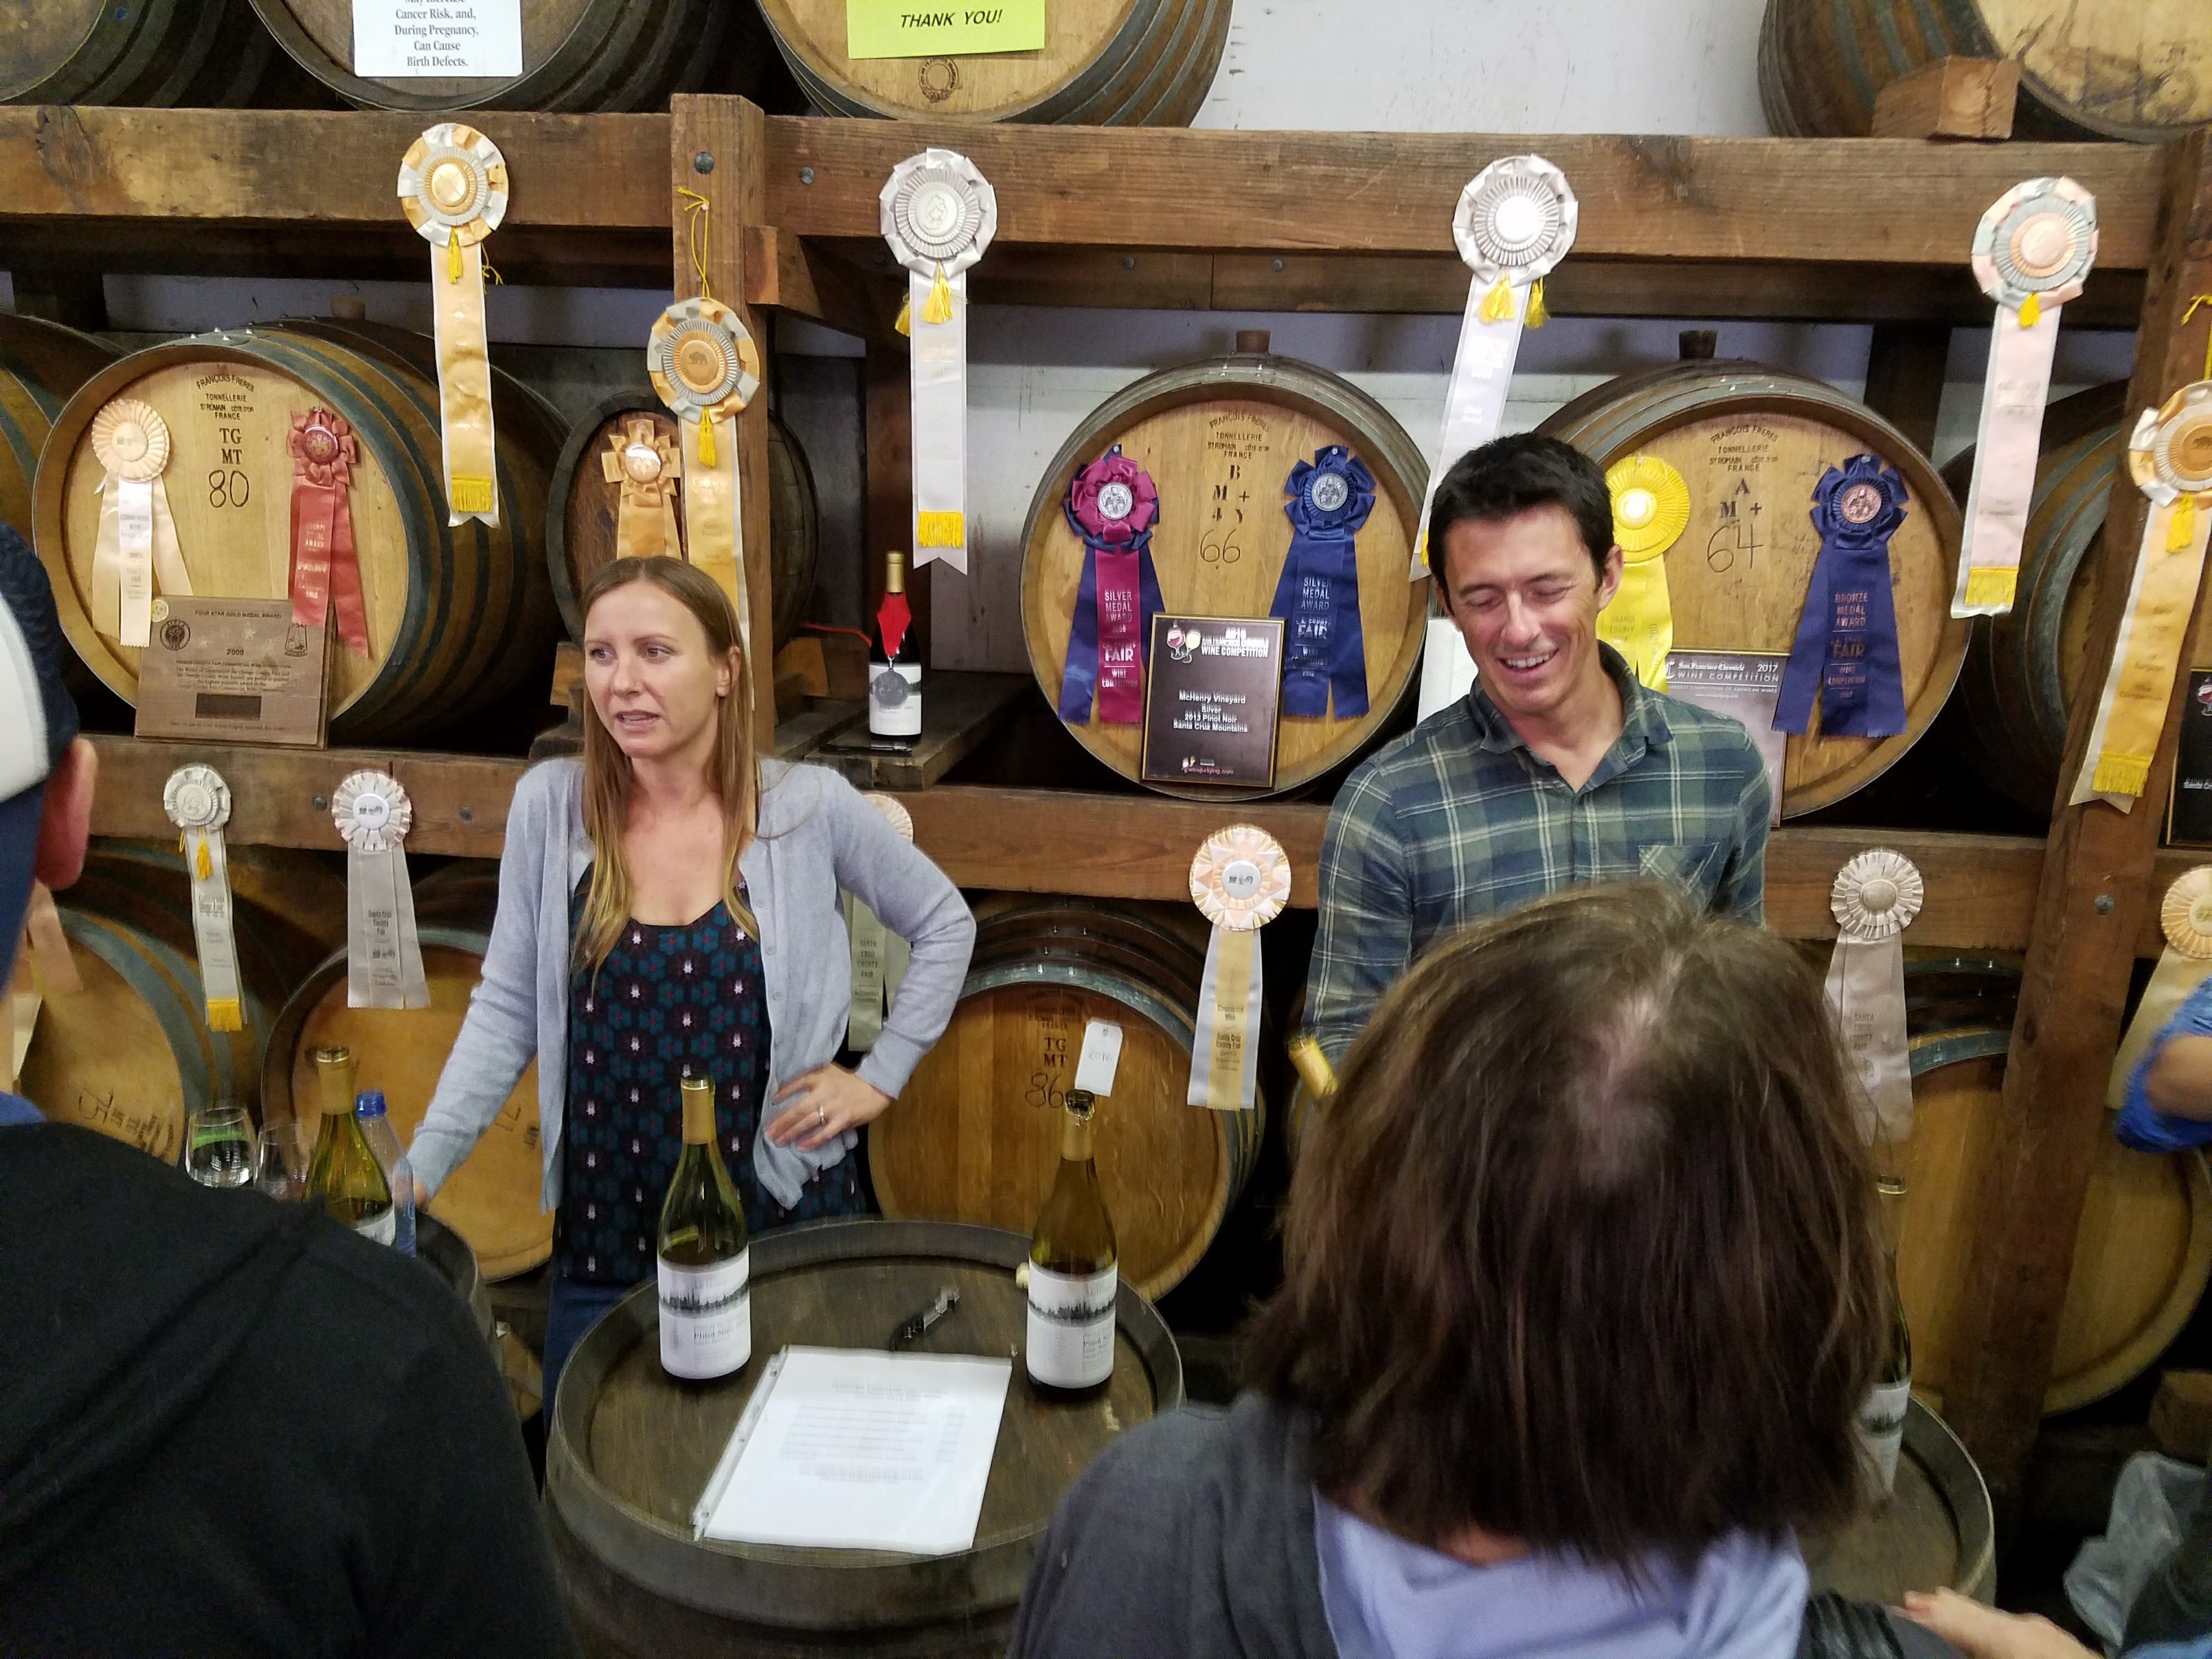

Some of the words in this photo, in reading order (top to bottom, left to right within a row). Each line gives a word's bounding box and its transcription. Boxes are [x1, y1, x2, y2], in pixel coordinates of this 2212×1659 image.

[396, 8, 427, 19] Cancer
[430, 8, 454, 20] Risk,
[455, 8, 476, 20] and,
[900, 12, 956, 28] THANK
[964, 9, 1003, 25] YOU!
[394, 25, 427, 37] During
[429, 25, 479, 37] Pregnancy,
[414, 41, 431, 51] Can
[433, 41, 461, 51] Cause
[407, 56, 430, 66] Birth
[432, 56, 469, 66] Defects.
[205, 393, 247, 402] TONNELLERIE
[215, 411, 241, 420] FRANCE
[219, 428, 242, 444] TG
[1216, 432, 1262, 442] TONNELLERIE
[1224, 450, 1252, 459] FRANCE
[1718, 444, 1769, 454] TONNELLERIE
[221, 448, 242, 465] MT
[1229, 465, 1240, 480] B
[1727, 464, 1760, 472] FRANCE
[208, 469, 249, 508] 80
[1735, 478, 1750, 495] A
[1212, 485, 1227, 500] M
[1719, 501, 1737, 518] M
[1200, 528, 1241, 563] 66
[1707, 523, 1764, 572] 64
[1304, 577, 1331, 588] SILVER
[1104, 591, 1132, 601] SILVER
[1302, 588, 1330, 599] MEDAL
[1835, 592, 1868, 603] BRONZE
[1105, 602, 1132, 612] MEDAL
[1301, 600, 1329, 611] AWARD
[1105, 613, 1132, 623] AWARD
[1836, 617, 1866, 627] AWARD
[1297, 624, 1328, 640] FAIR
[1105, 647, 1133, 662] FAIR
[1201, 646, 1220, 656] WINE
[1221, 647, 1268, 658] COMPETITION
[1757, 663, 1779, 673] 2017
[1709, 673, 1779, 682] COMPETITION
[1044, 1037, 1066, 1052] TG
[1043, 1053, 1068, 1068] MT
[1025, 1072, 1064, 1109] 86
